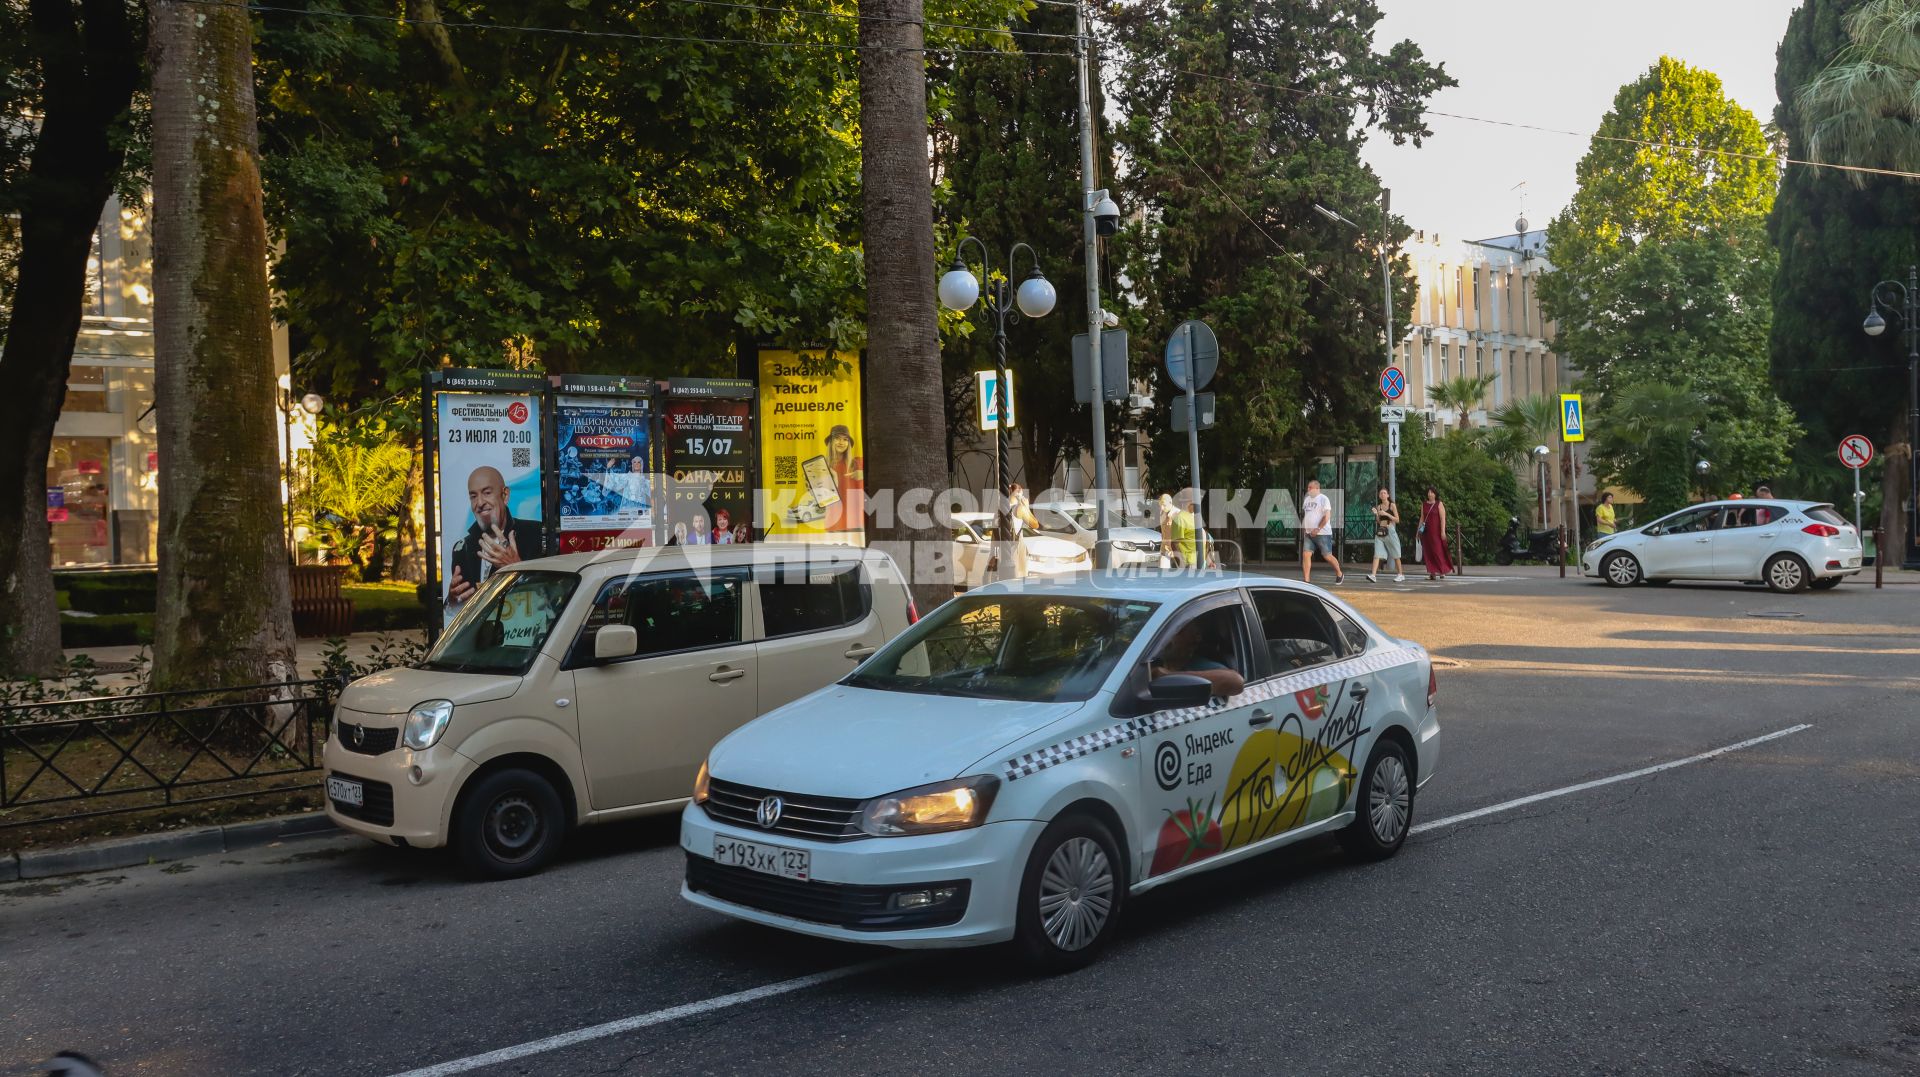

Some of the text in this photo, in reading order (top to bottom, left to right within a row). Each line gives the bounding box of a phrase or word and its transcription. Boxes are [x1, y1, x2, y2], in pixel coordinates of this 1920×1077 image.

[773, 363, 834, 377] Закажи
[451, 379, 467, 387] (862)
[773, 384, 818, 394] такси
[451, 407, 509, 418] ФЕСТИВАЛЬНЫЙ
[609, 408, 631, 417] 16-20
[569, 417, 640, 427] НАЦИОНАЛЬНОЕ
[673, 412, 743, 425] ЗЕЛЁНЫЙ ТЕАТР
[574, 426, 634, 435] ШОУ РОССИИ
[774, 430, 815, 440] maxim
[448, 429, 532, 444] 23 ИЮЛЯ 20:00
[580, 437, 629, 446] КОСТРОМА
[686, 438, 732, 456] 15/07
[673, 469, 745, 484] ОДНАЖДЫ
[675, 491, 745, 500] РОССИИ
[1185, 728, 1235, 757] Яндекс
[1187, 763, 1212, 786] Еда
[780, 850, 807, 871] 123
